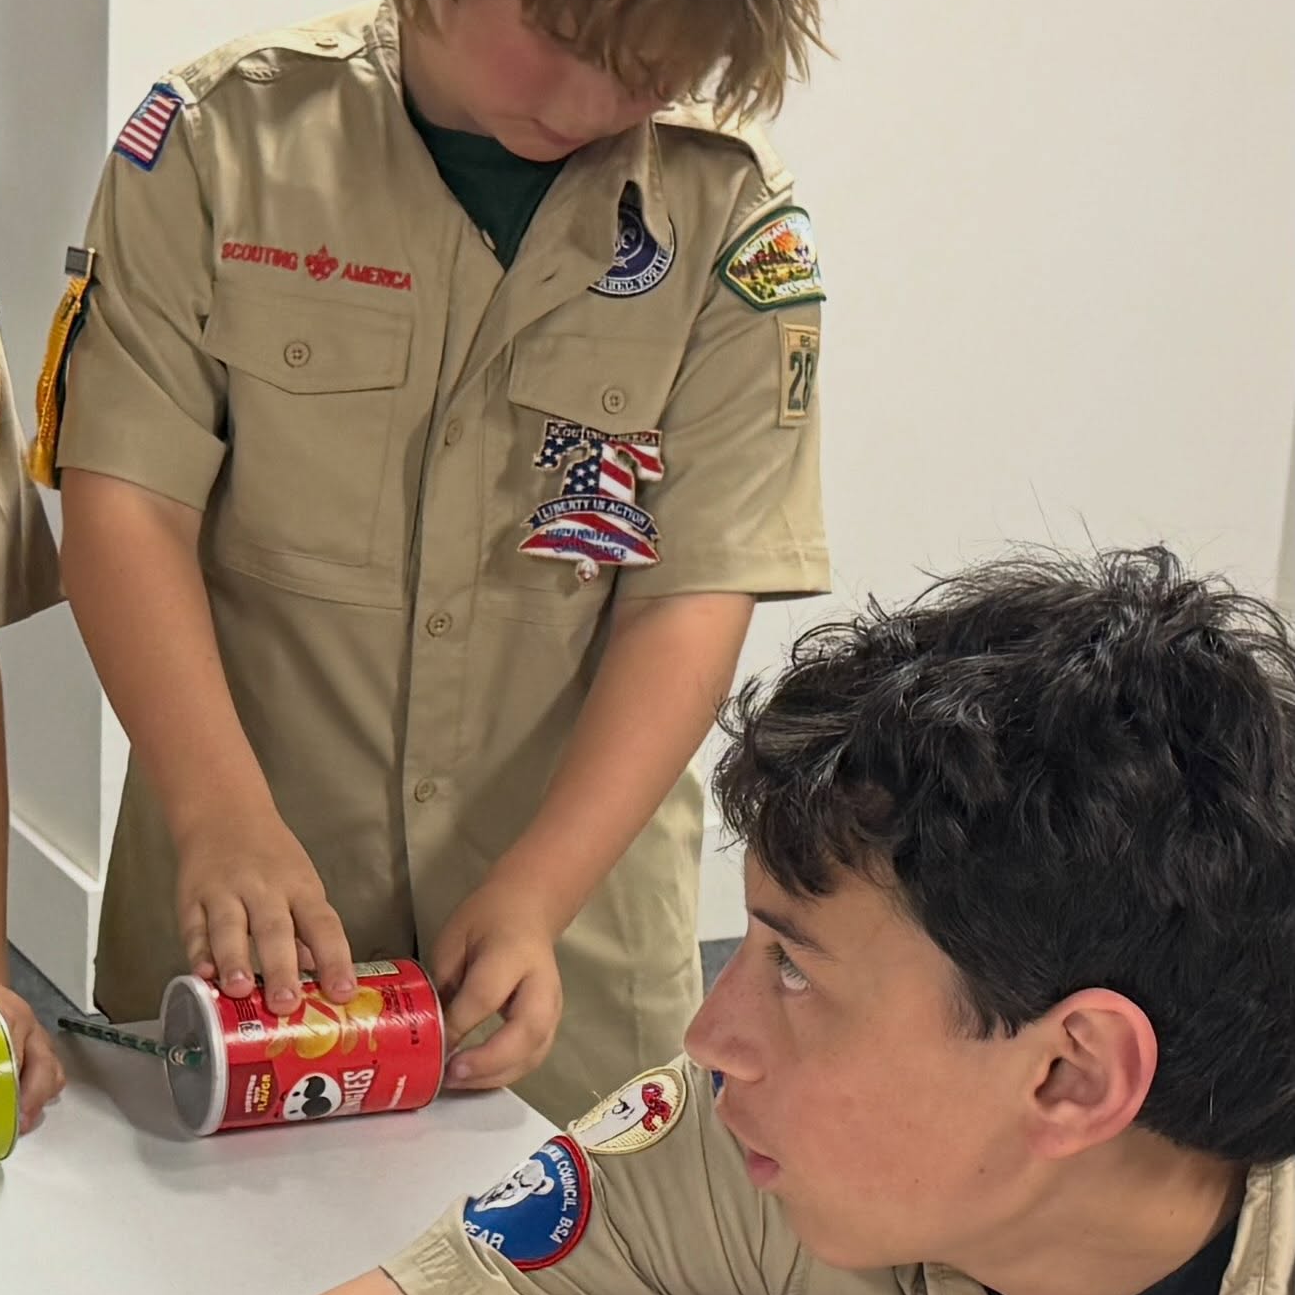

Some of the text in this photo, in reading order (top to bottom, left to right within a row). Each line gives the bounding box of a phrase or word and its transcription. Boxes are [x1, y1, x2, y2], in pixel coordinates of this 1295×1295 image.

[221, 241, 413, 292] SCOUTING AMERICA
[542, 498, 648, 526] LIBERTY IN ACTION
